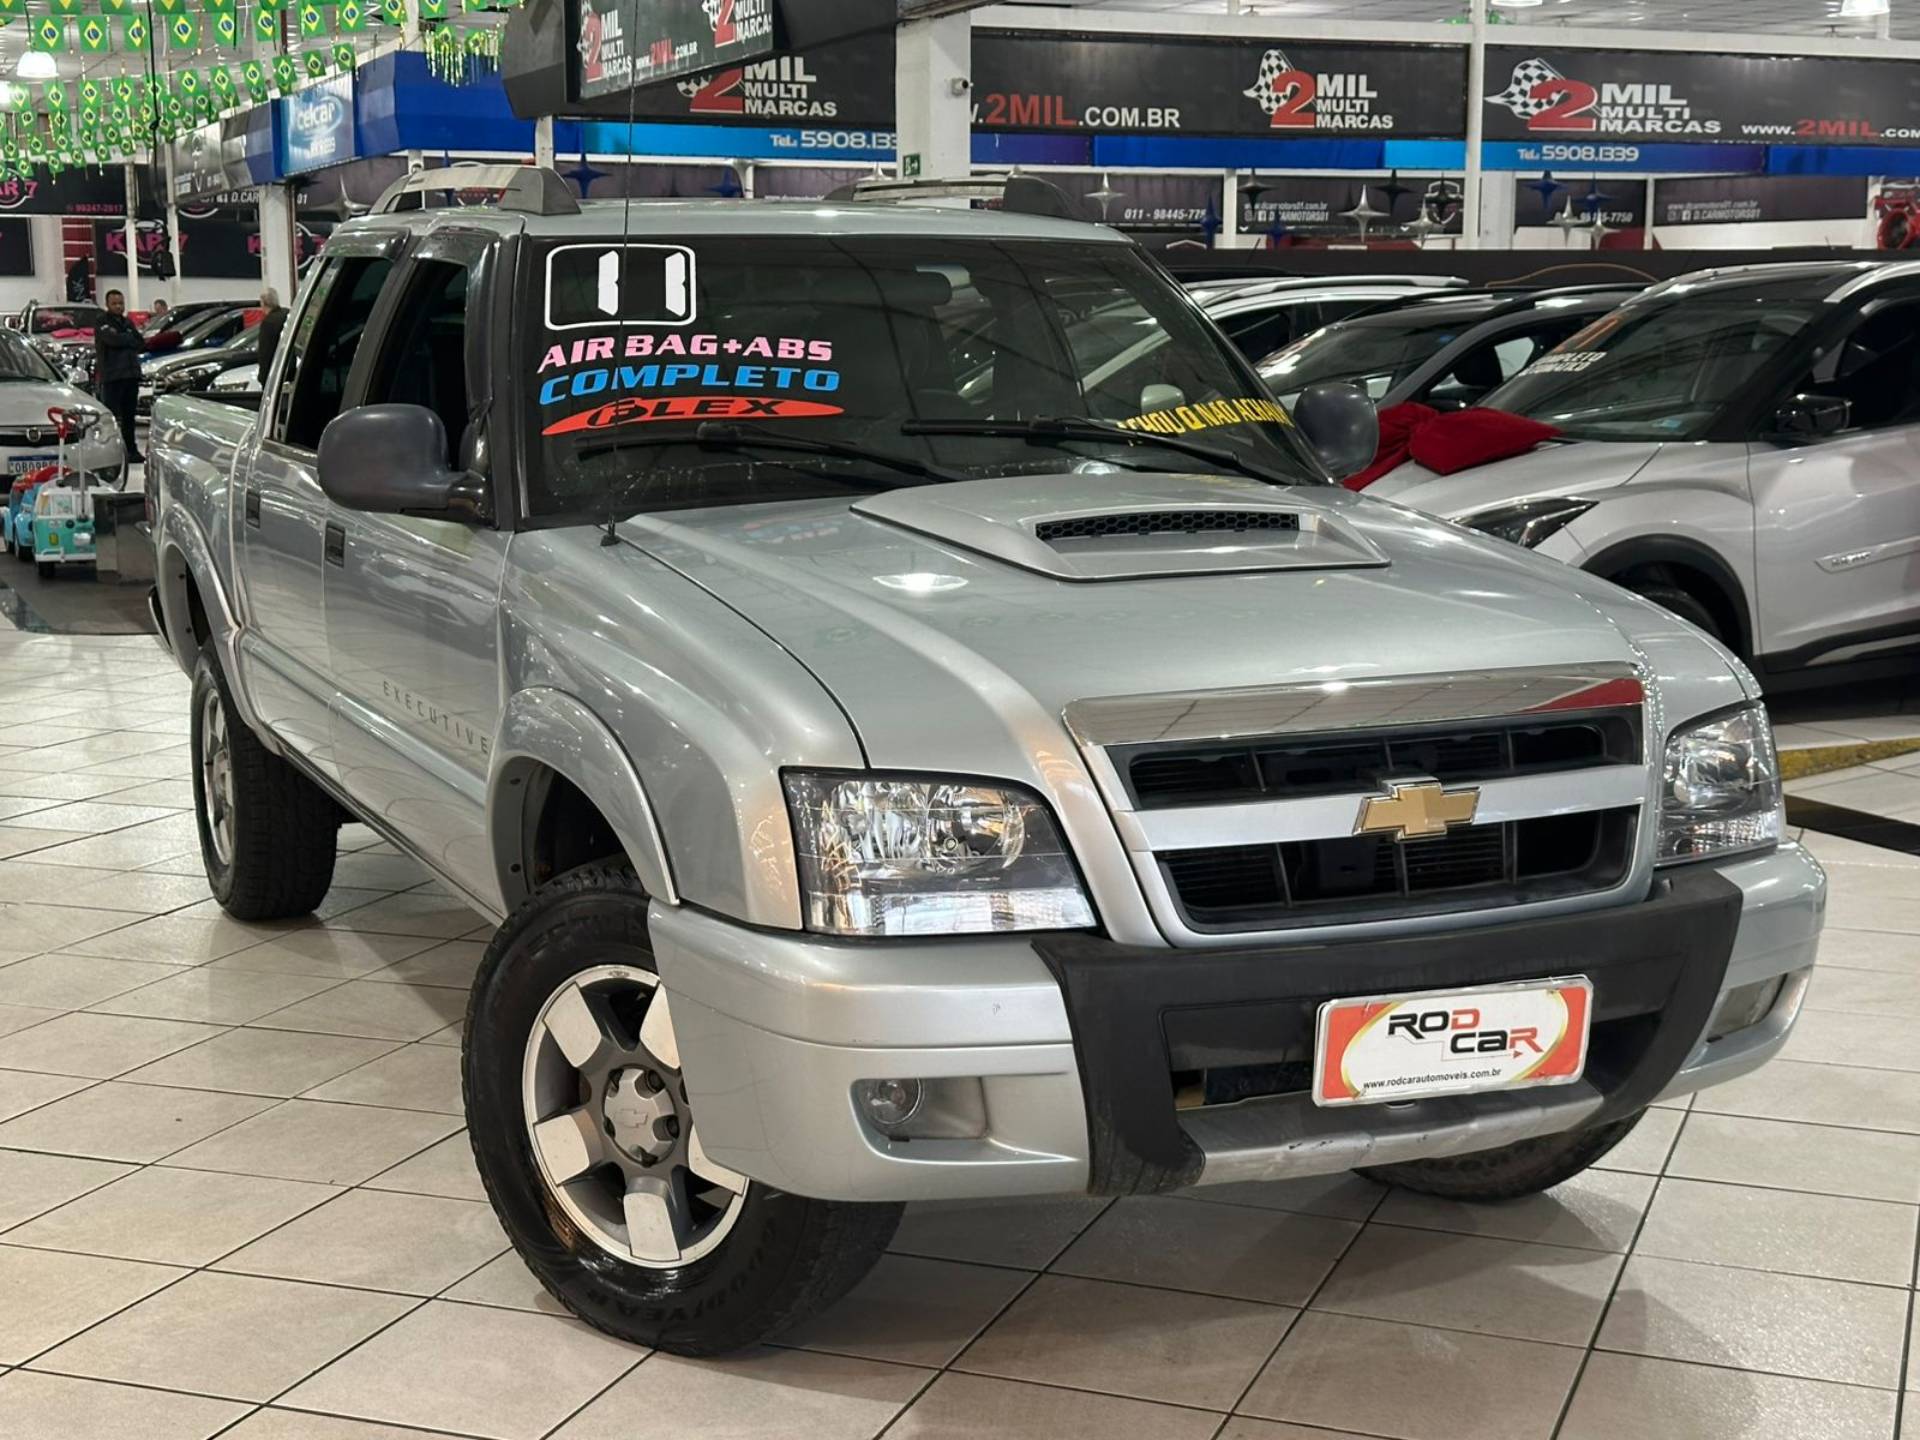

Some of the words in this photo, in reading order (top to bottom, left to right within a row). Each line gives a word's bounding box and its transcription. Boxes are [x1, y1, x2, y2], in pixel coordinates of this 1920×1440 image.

[601, 9, 623, 41] MIL
[601, 39, 624, 61] MULTI
[602, 55, 632, 78] MARCAS
[744, 56, 817, 83] MIL
[744, 82, 808, 99] MULTI
[1270, 70, 1315, 129] 2
[1316, 73, 1377, 98] MIL
[744, 99, 838, 117] MARCAS
[1316, 99, 1369, 113] MULTI
[1528, 79, 1598, 131] 2
[1601, 83, 1688, 106] MIL
[1601, 106, 1691, 120] MULTI
[1316, 113, 1394, 129] MARCAS
[1601, 119, 1722, 133] MARCAS
[1541, 145, 1640, 162] 5908.1339
[1124, 208, 1145, 220] 011
[598, 250, 686, 317] 11
[537, 337, 615, 374] AIR
[624, 334, 833, 362] BAG+ABS
[539, 364, 841, 405] COMPLETO
[588, 397, 784, 427] FLEX
[1116, 409, 1186, 434] CHOU
[1175, 406, 1207, 431] Q
[383, 680, 488, 755] EXECUTIVE
[1387, 1008, 1480, 1039] ROD
[1362, 1068, 1502, 1090] www.rodcarautomoveis.com.br
